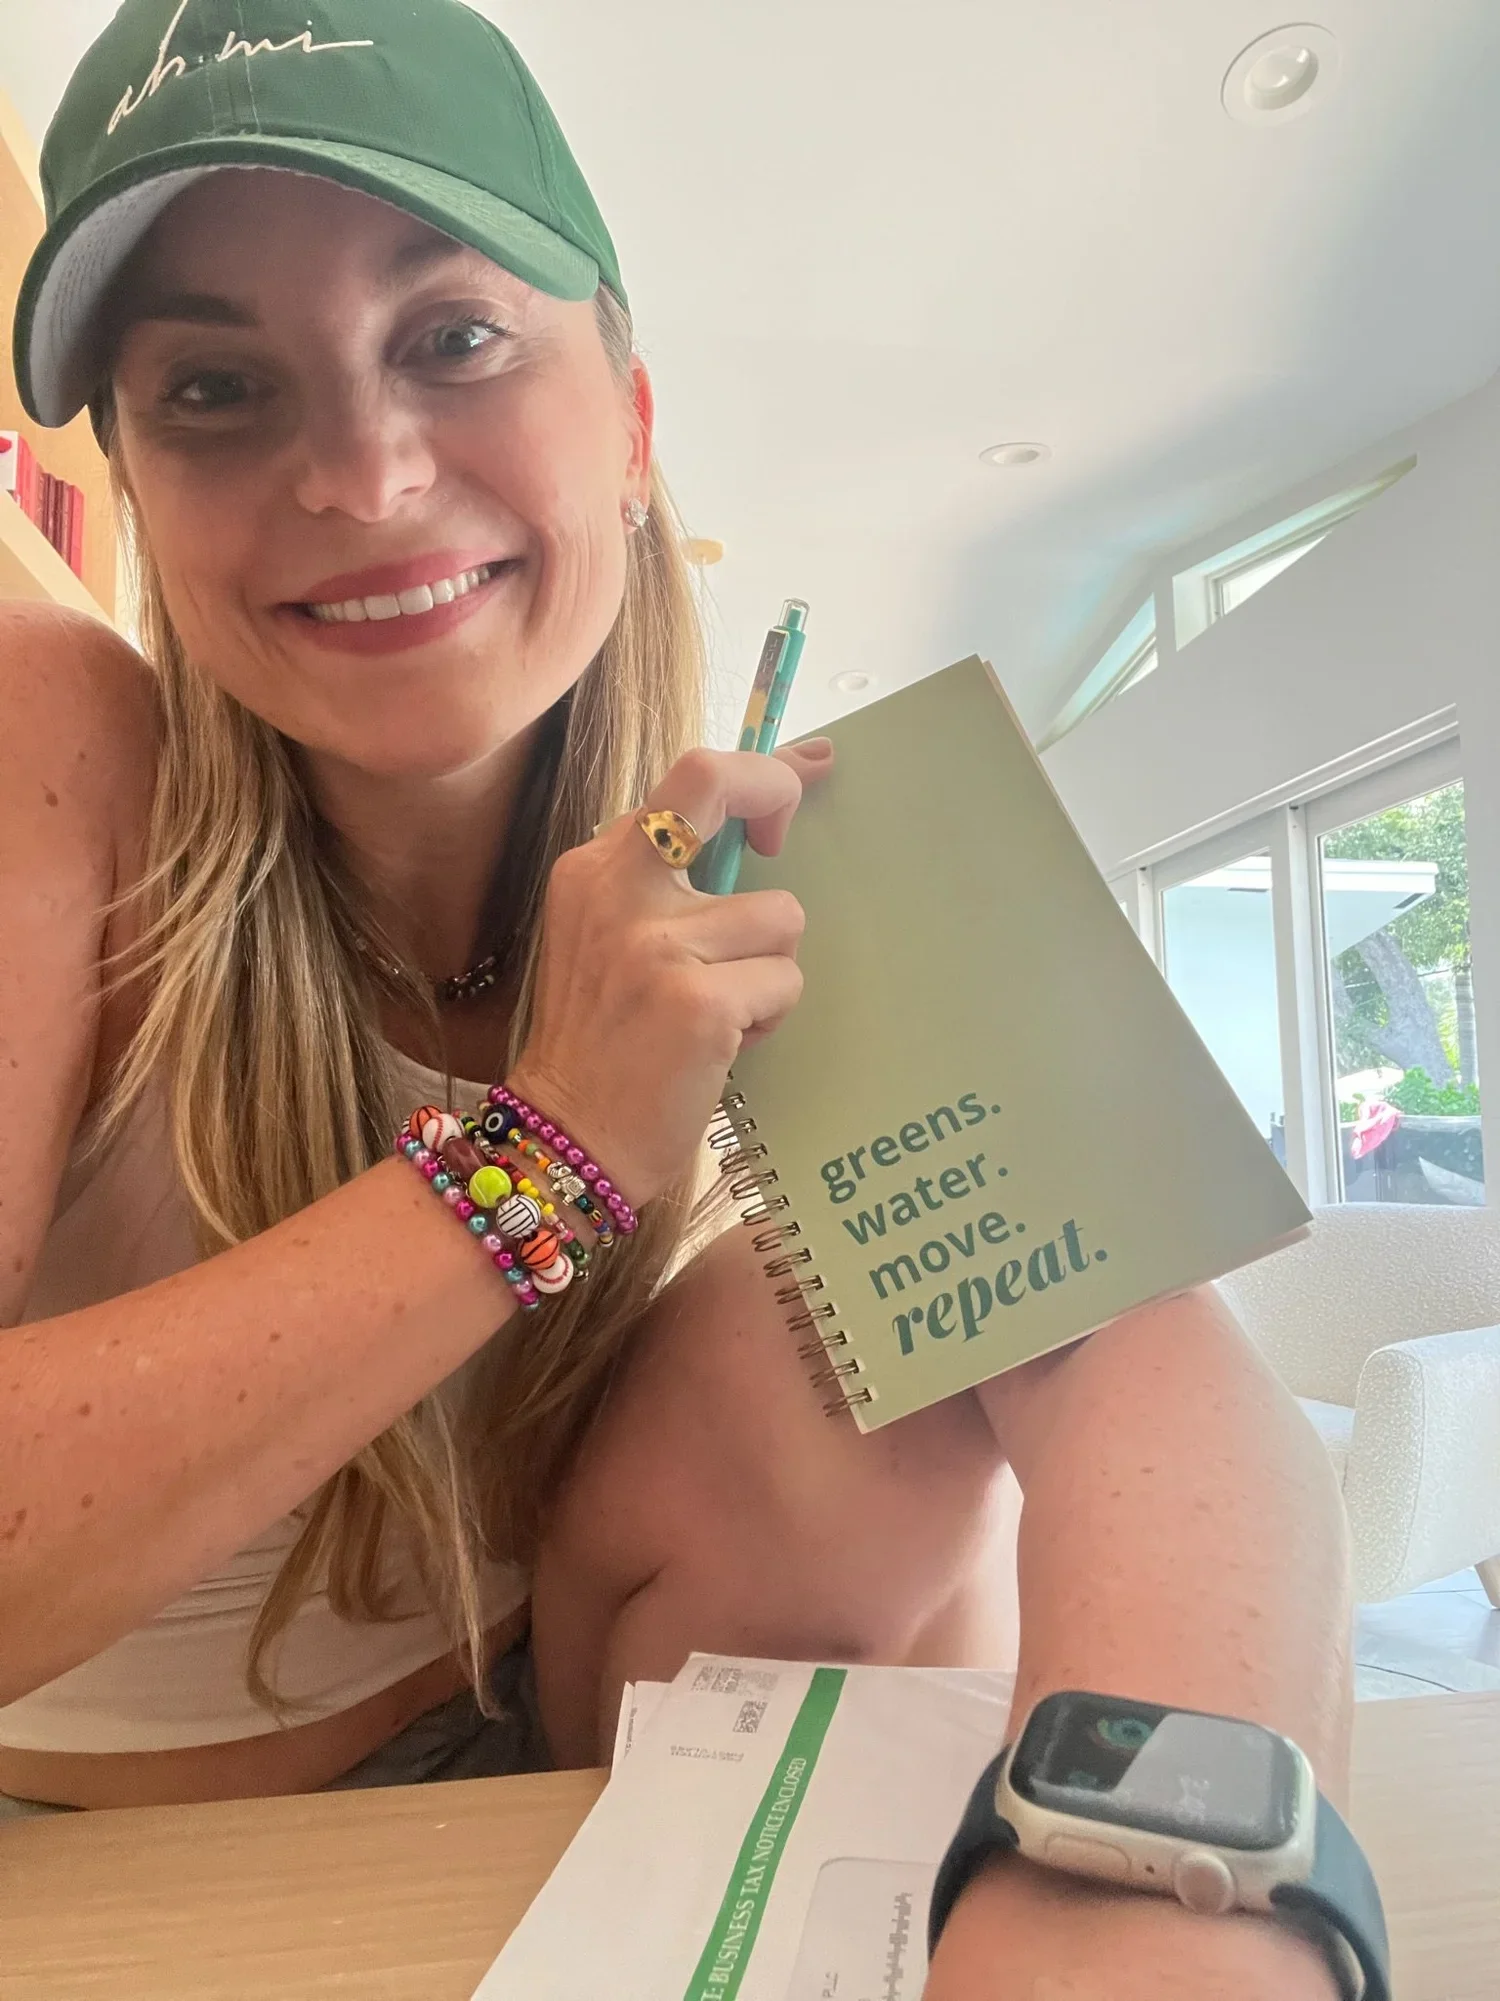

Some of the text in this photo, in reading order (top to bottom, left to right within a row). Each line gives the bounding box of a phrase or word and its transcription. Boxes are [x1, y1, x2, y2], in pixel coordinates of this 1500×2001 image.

[821, 1092, 1001, 1203] greens.
[842, 1152, 1008, 1245] water.
[868, 1210, 1025, 1298] move.
[892, 1219, 1108, 1355] repeat.
[771, 1757, 807, 1813] ENCLOSED
[751, 1813, 785, 1861] NOTICE
[740, 1865, 766, 1896] TAX
[708, 1899, 755, 1983] BUSINESS
